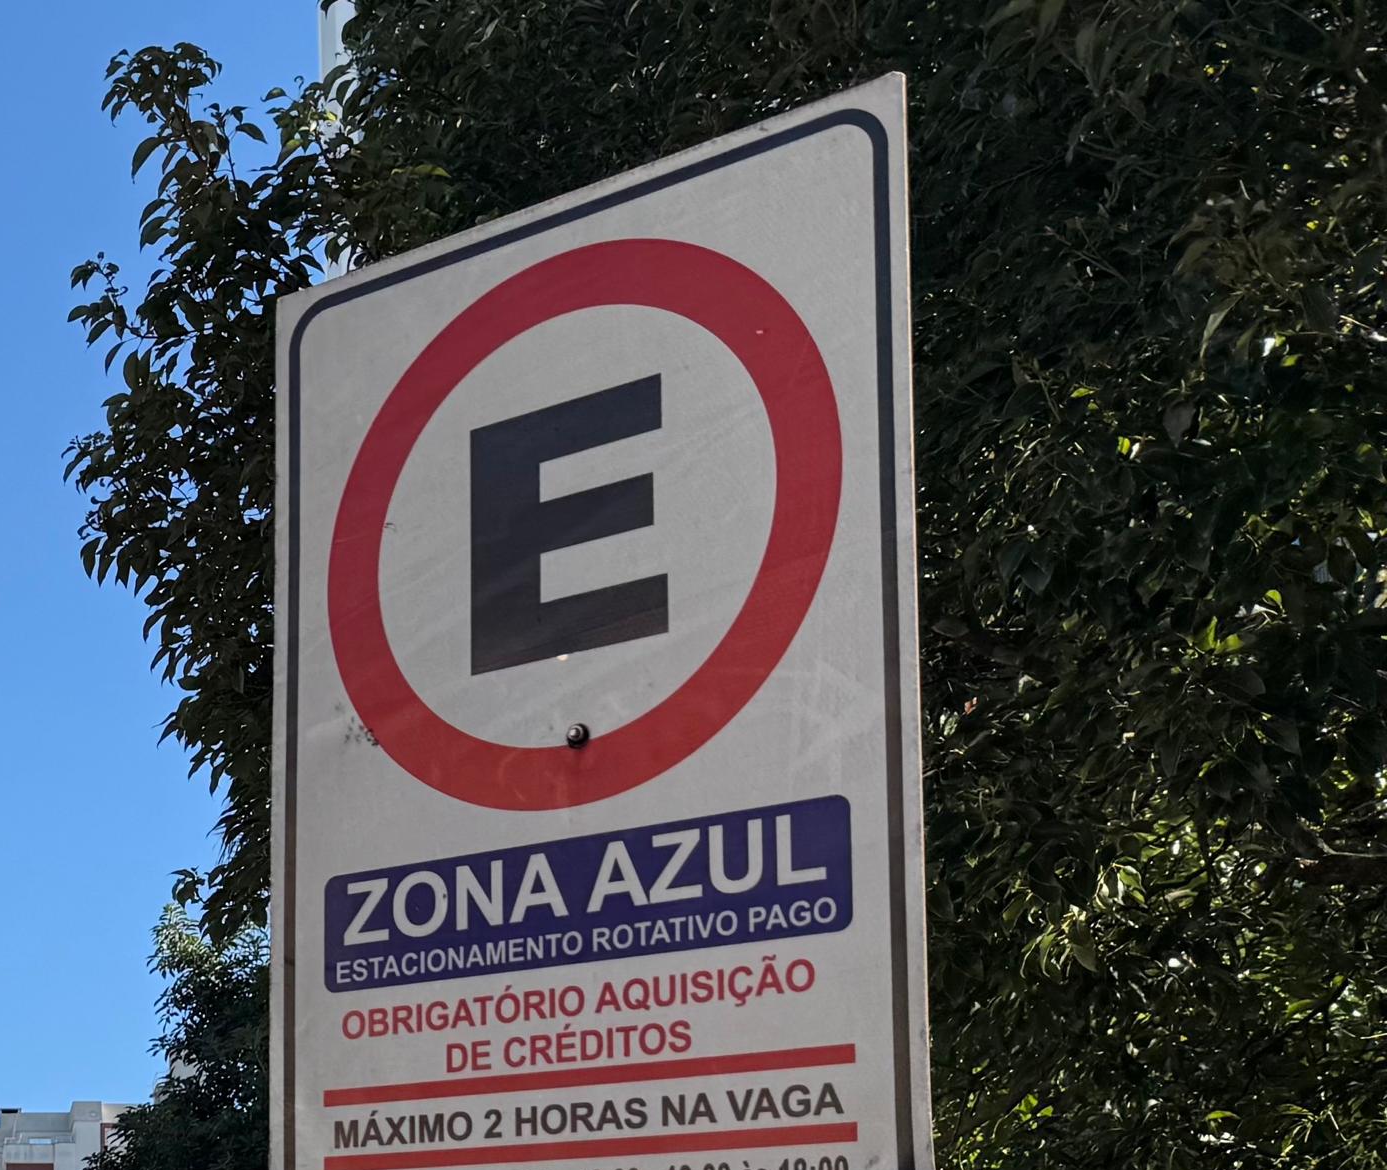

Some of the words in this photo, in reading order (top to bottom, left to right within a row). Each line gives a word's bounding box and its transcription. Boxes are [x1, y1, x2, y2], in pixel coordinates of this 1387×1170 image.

[470, 373, 668, 675] E
[343, 852, 569, 946] ZONA
[586, 814, 827, 913] AZUL
[336, 931, 583, 984] ESTACIONAMENTO
[592, 910, 738, 952] ROTATIVO
[748, 897, 837, 933] PAGO
[341, 985, 585, 1040] OBRIGATÓRIO
[594, 954, 816, 1014] AQUISIÇÃO
[446, 1040, 492, 1073] DE
[503, 1020, 692, 1068] CRÉDITOS
[334, 1110, 473, 1149] MÁXIMO
[483, 1109, 503, 1139] 2
[515, 1098, 648, 1137] HORAS
[661, 1092, 717, 1127] NA
[726, 1082, 844, 1122] VAGA
